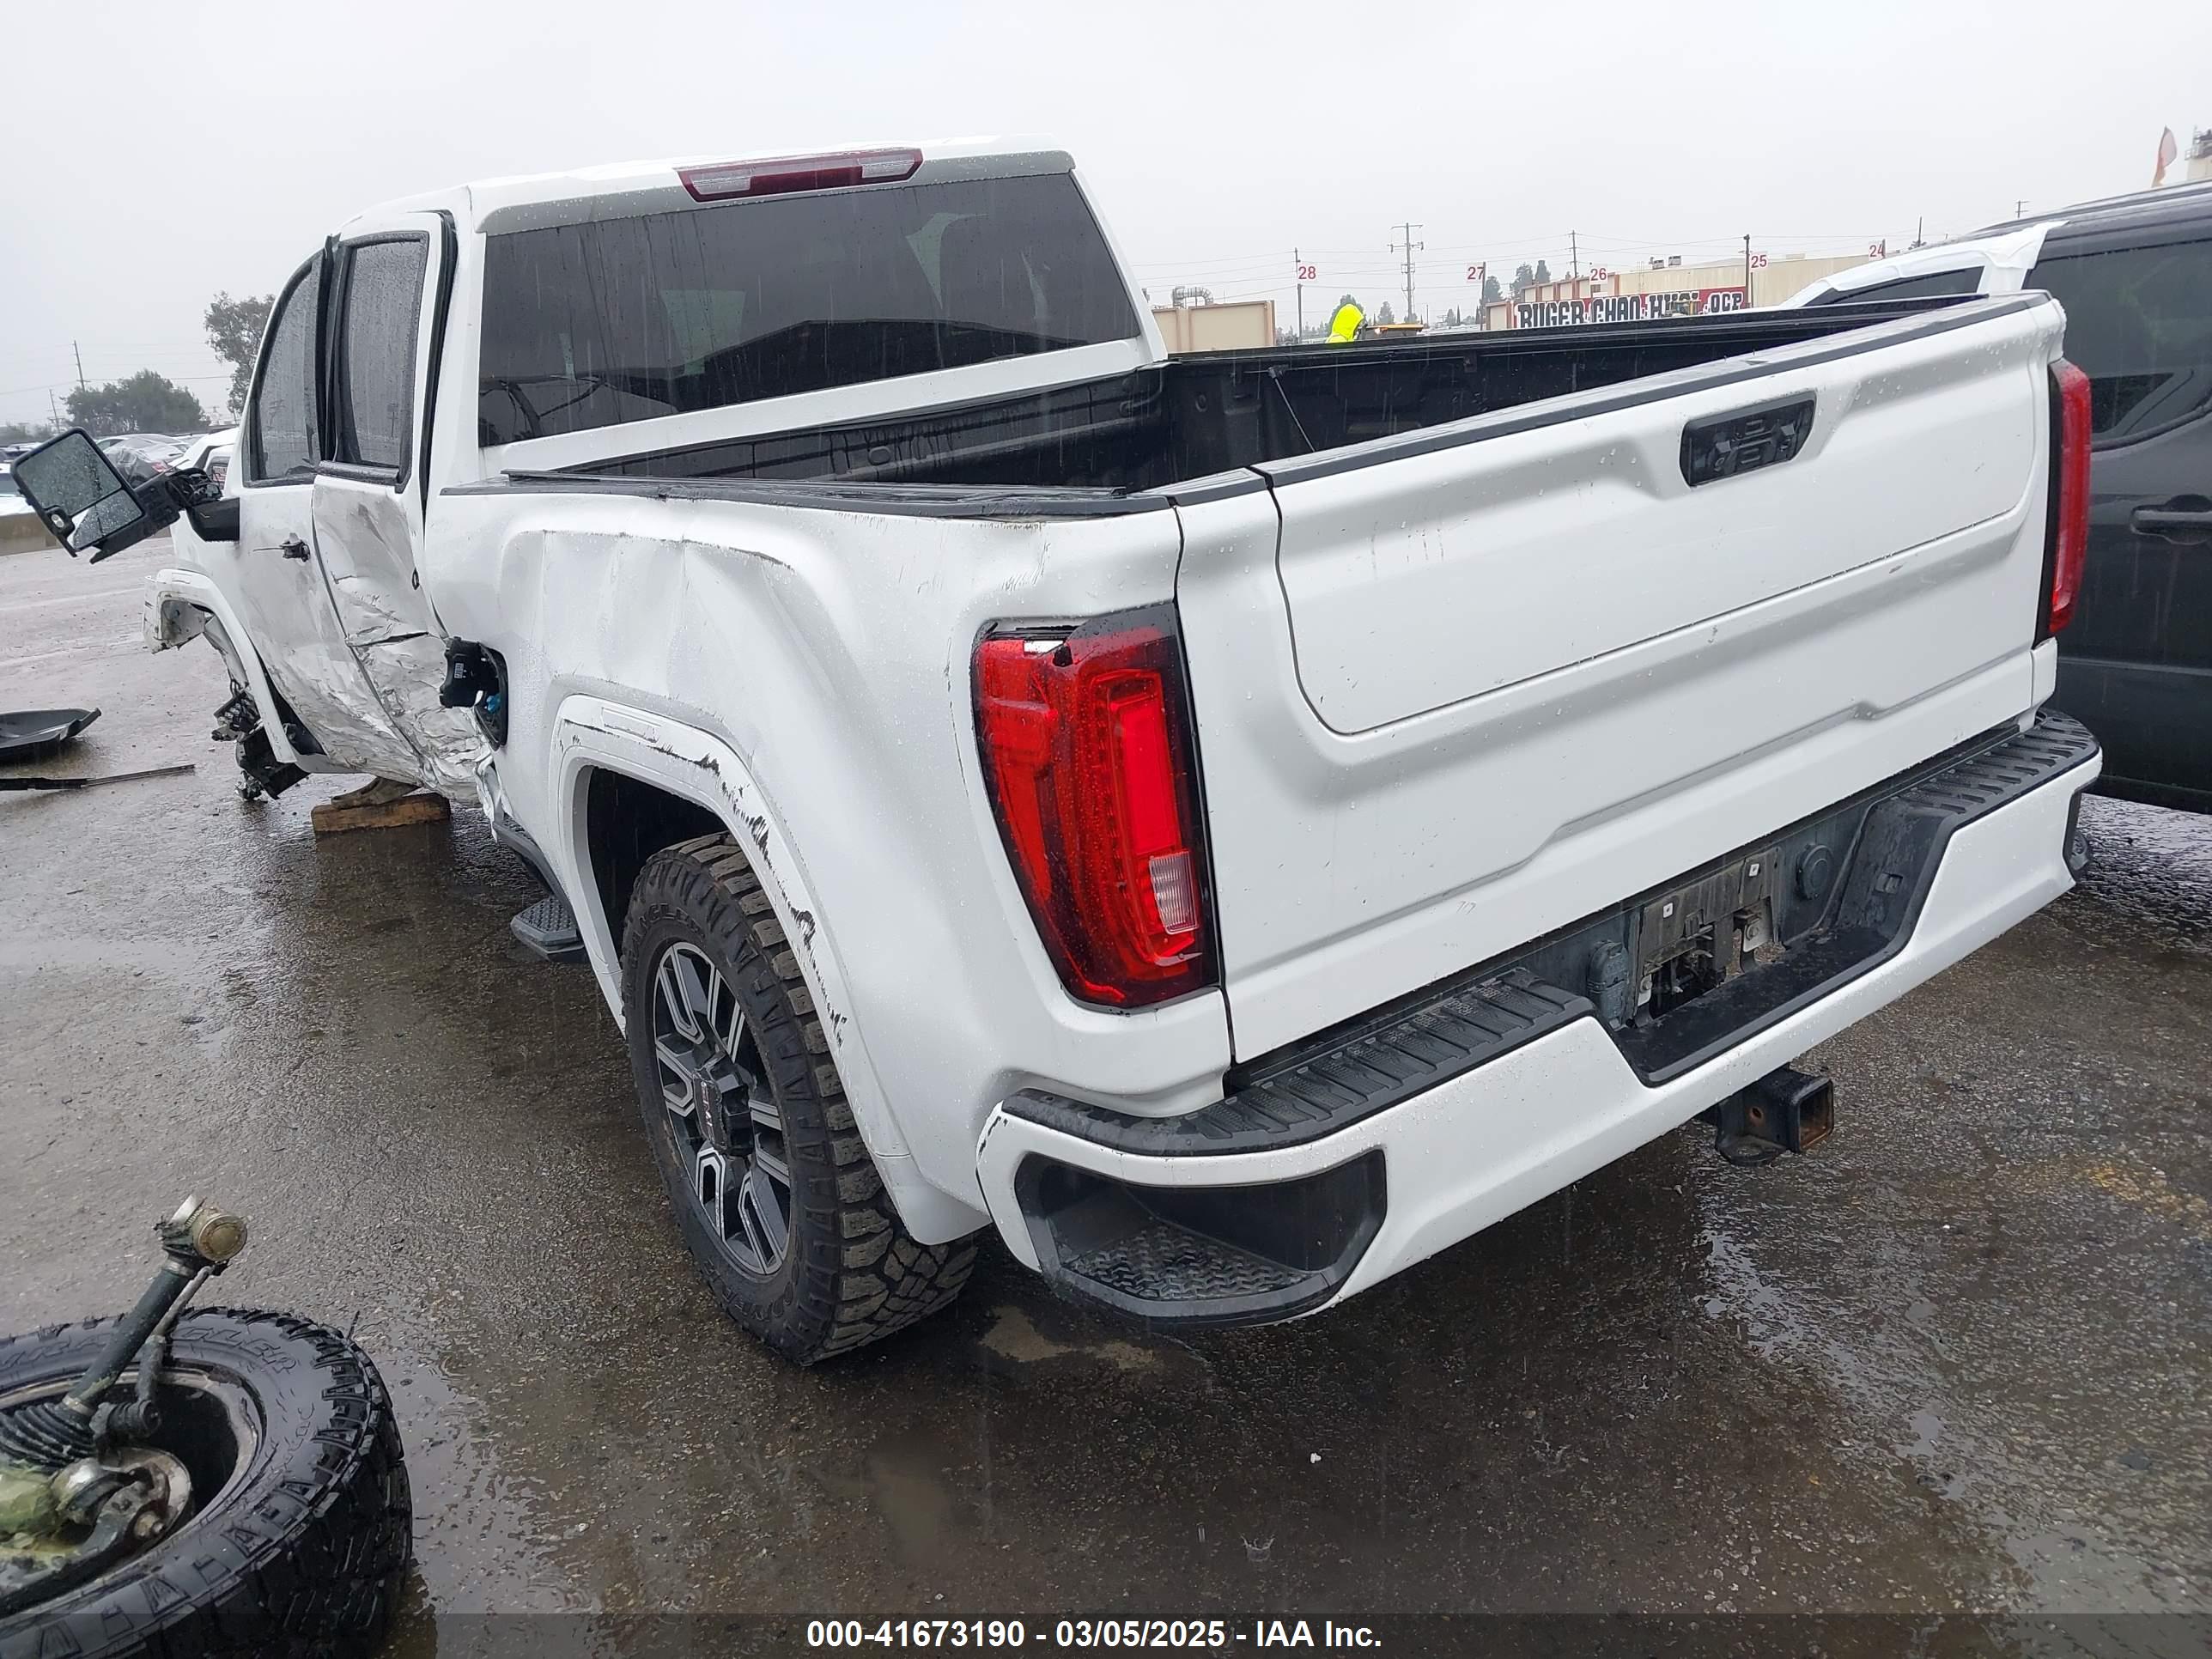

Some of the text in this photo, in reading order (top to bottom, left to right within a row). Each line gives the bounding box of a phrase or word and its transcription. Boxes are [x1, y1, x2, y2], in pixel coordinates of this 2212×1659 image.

[1869, 244, 1884, 258] 24
[1751, 254, 1767, 268] 25
[1297, 265, 1316, 280] 28
[1468, 266, 1485, 280] 27
[1590, 267, 1607, 281] 26
[1710, 291, 1743, 313] OCP
